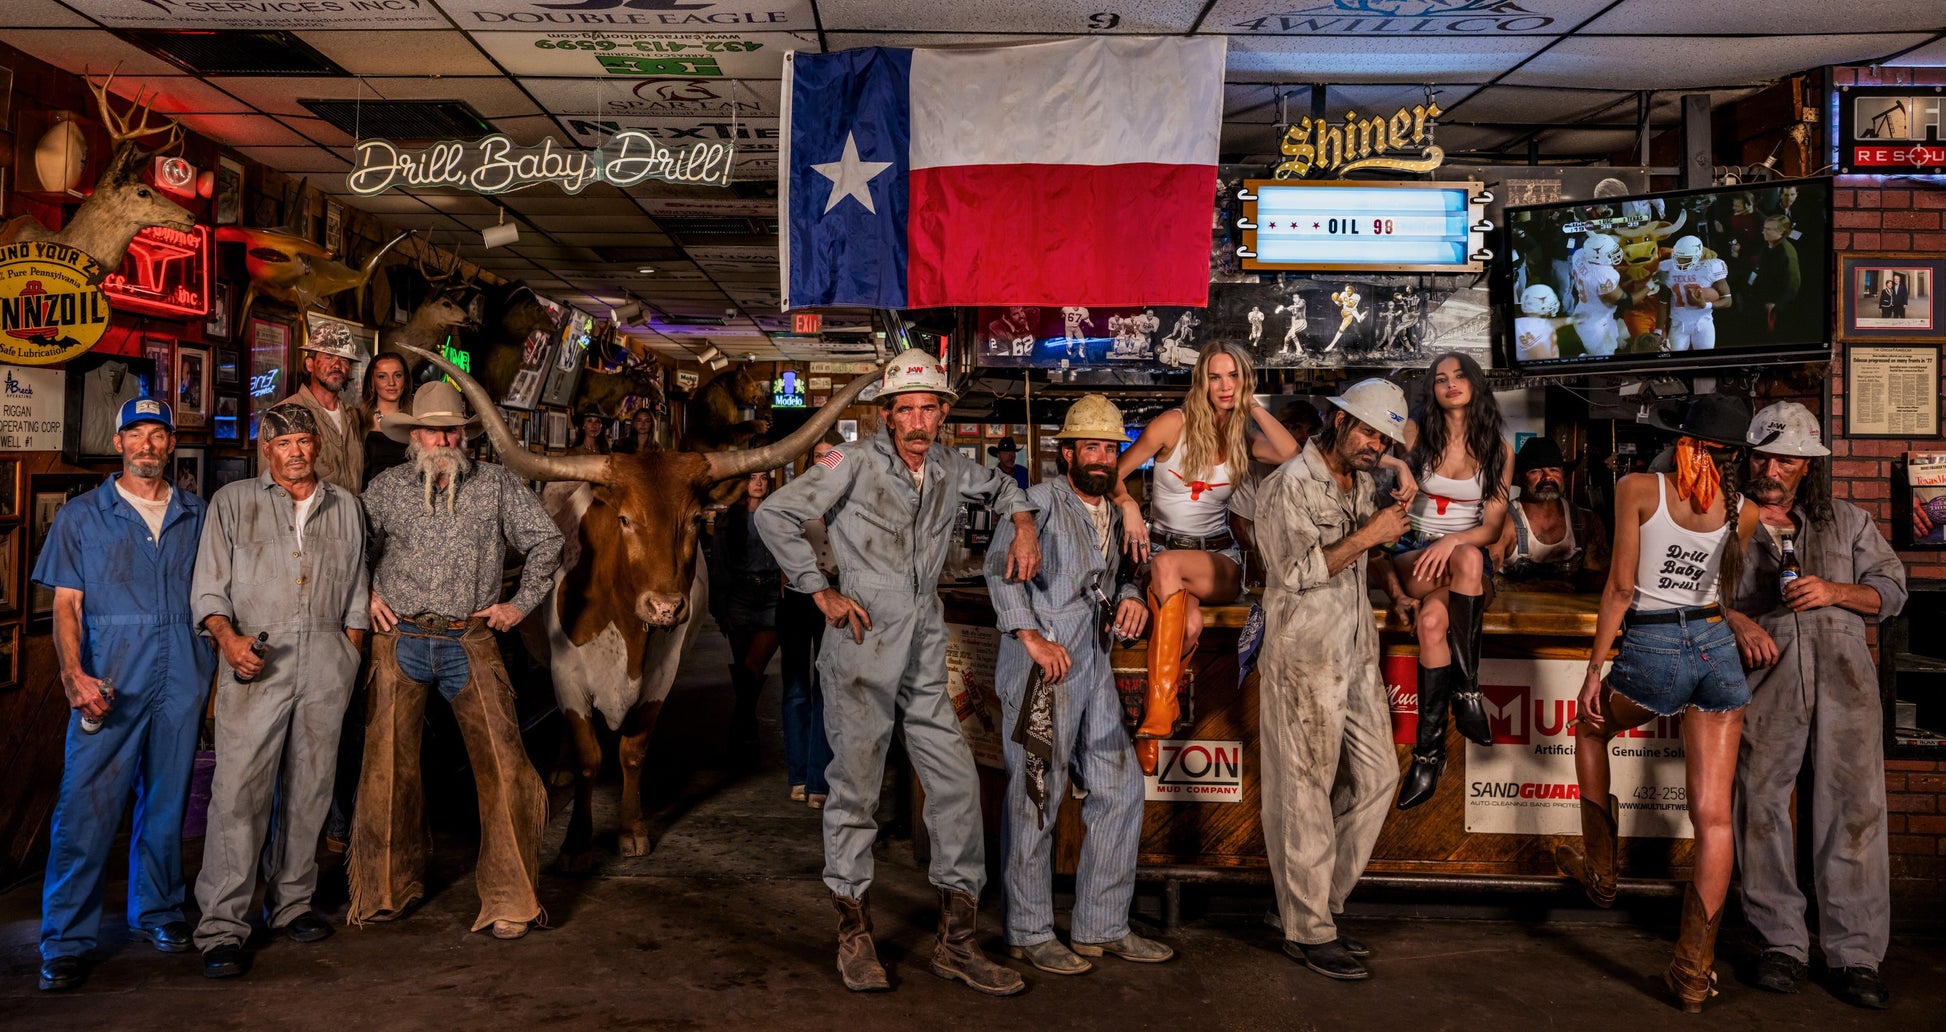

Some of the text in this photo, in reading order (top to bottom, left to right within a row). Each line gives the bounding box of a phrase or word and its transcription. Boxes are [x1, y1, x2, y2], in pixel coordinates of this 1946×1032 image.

[185, 0, 415, 13] SERVICES INC.
[471, 11, 788, 25] DOUBLE EAGLE
[1231, 17, 1555, 32] 4WILLCO
[534, 40, 764, 52] 432-413-6599
[608, 100, 761, 111] SPARTAN
[1274, 102, 1444, 180] Shiner
[605, 131, 734, 188] Drill!
[1328, 218, 1360, 234] OIL
[36, 243, 80, 266] YOUR
[8, 267, 81, 289] Pure Pennsylvania
[1672, 274, 1697, 282] TEXAS
[1, 291, 105, 330] NNZOIL
[1067, 312, 1082, 323] 67
[795, 314, 818, 333] EXIT
[0, 343, 67, 358] Safe Lubrication
[1012, 335, 1034, 357] 62
[775, 395, 804, 406] Modelo
[3, 405, 32, 418] RIGGAN
[41, 421, 62, 433] CORP.
[0, 436, 33, 448] WELL #1
[1666, 544, 1709, 563] Drill
[1660, 560, 1706, 581] Baby
[1612, 746, 1660, 757] Genuine
[1186, 786, 1238, 794] COMPANY
